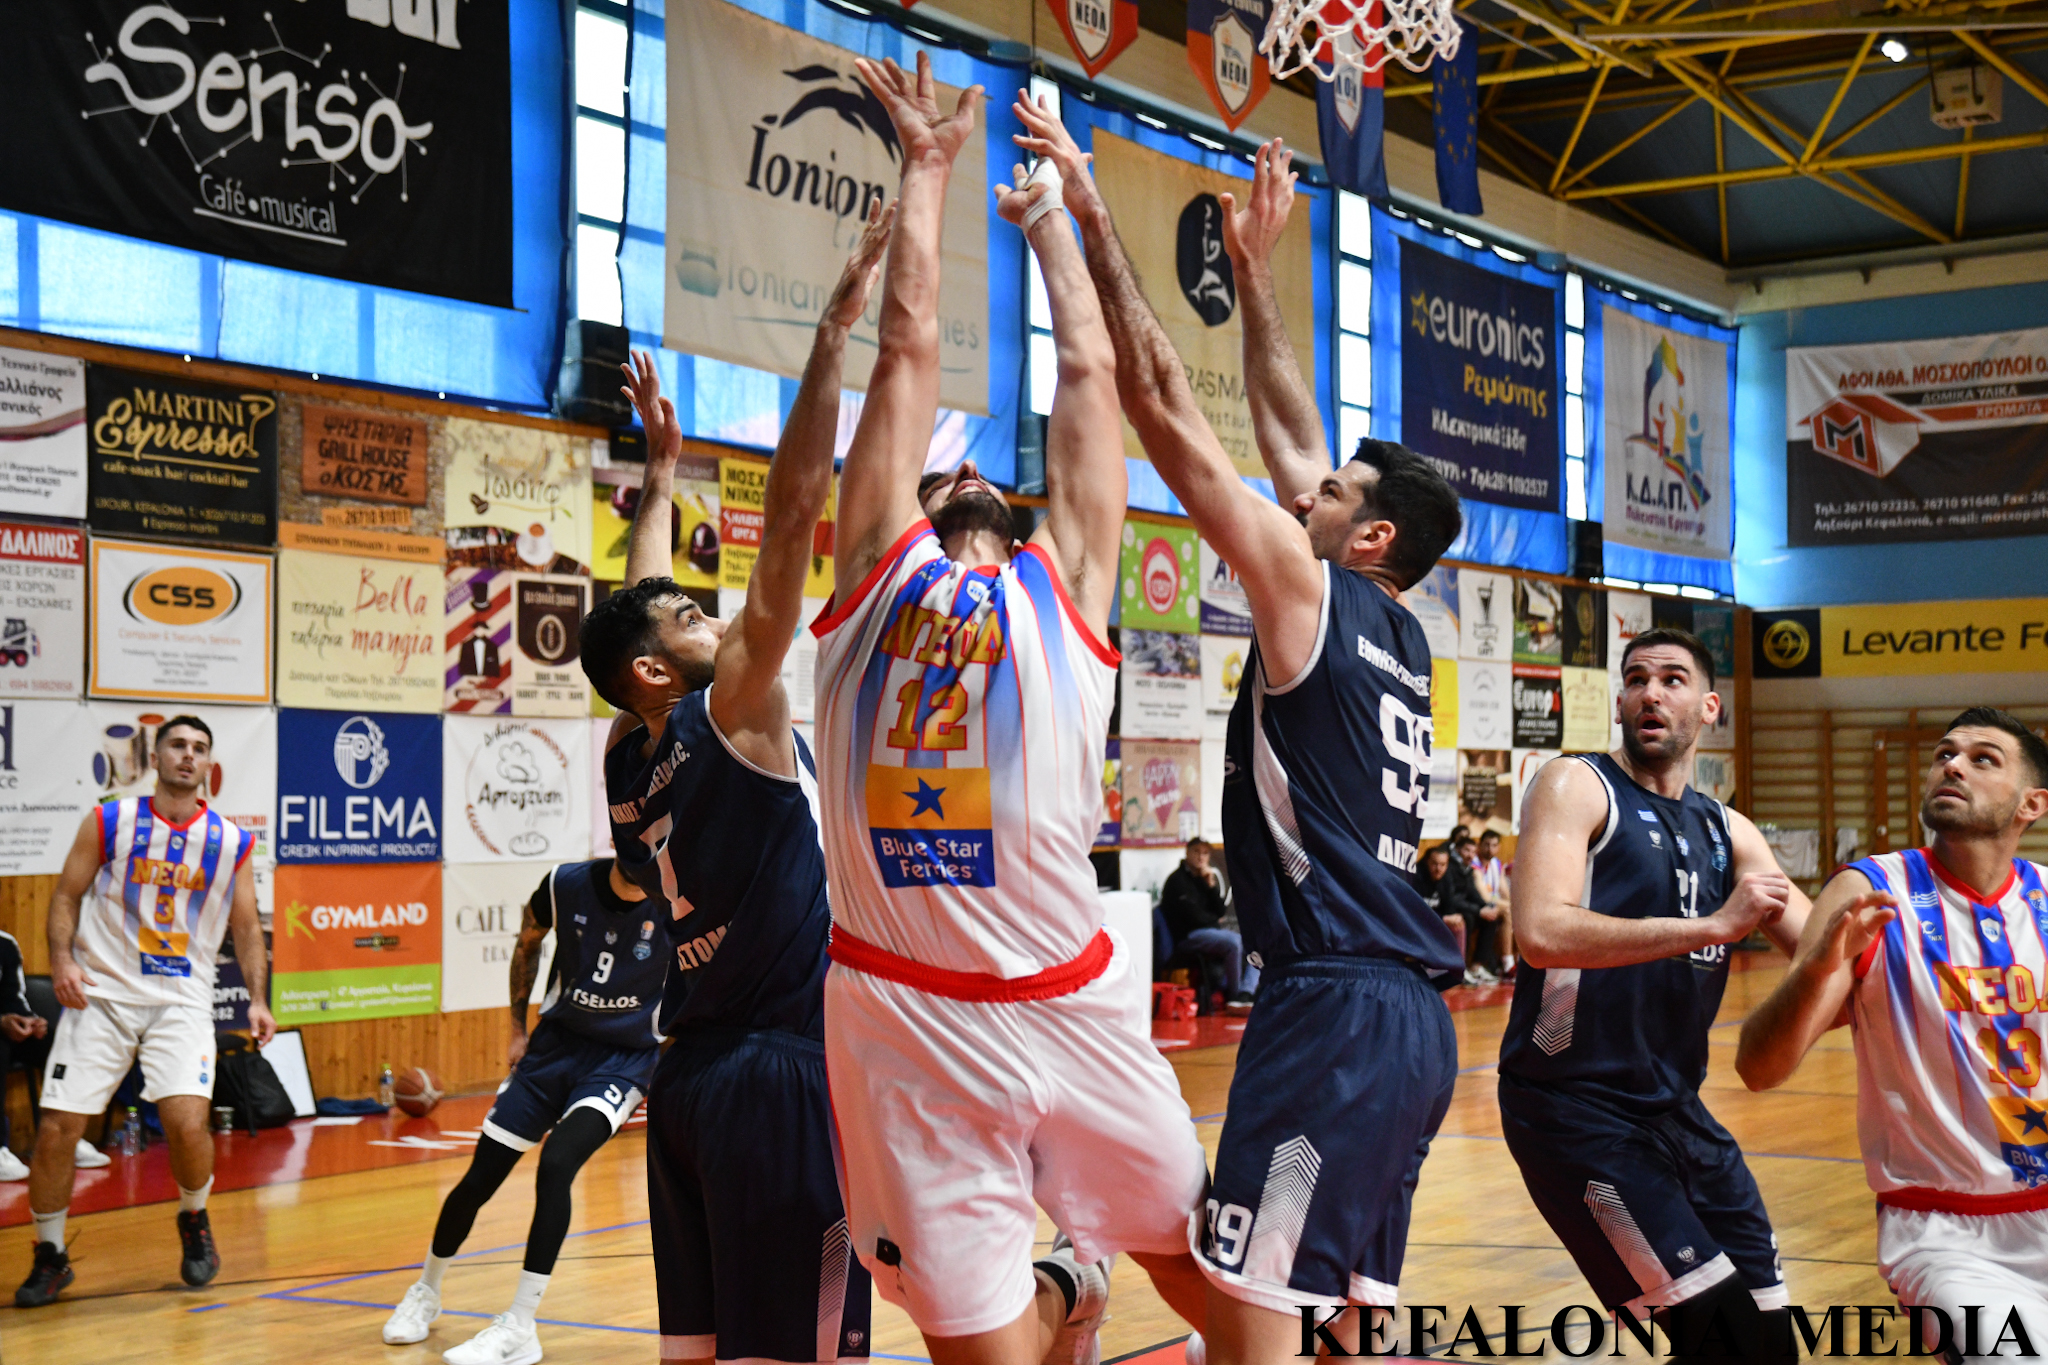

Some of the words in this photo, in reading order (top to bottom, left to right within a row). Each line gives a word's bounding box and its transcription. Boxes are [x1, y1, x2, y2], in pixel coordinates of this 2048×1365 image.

[84, 4, 434, 174] Senso
[1221, 59, 1248, 86] NEOA
[201, 173, 246, 216] Café
[260, 197, 338, 235] musical
[1429, 296, 1546, 369] euronics
[133, 387, 245, 427] MARTINI
[94, 397, 250, 461] Espresso
[361, 444, 410, 471] HOUSE
[0, 528, 80, 559] ΔΑΛΙΝΟΣ
[149, 583, 216, 609] CSS
[354, 566, 429, 620] Bella
[351, 625, 435, 675] mangia
[881, 603, 1007, 669] NEOA
[1843, 624, 2005, 656] Levante
[886, 679, 968, 751] 12
[280, 795, 437, 840] FILEMA
[639, 811, 695, 921] 7
[880, 836, 928, 857] Blue
[936, 837, 983, 858] Star
[130, 857, 206, 891] NEOA
[900, 860, 973, 880] Ferries
[154, 893, 176, 924] 3
[311, 902, 429, 931] GYMLAND
[592, 950, 615, 984] 9
[1976, 1027, 2042, 1088] 13
